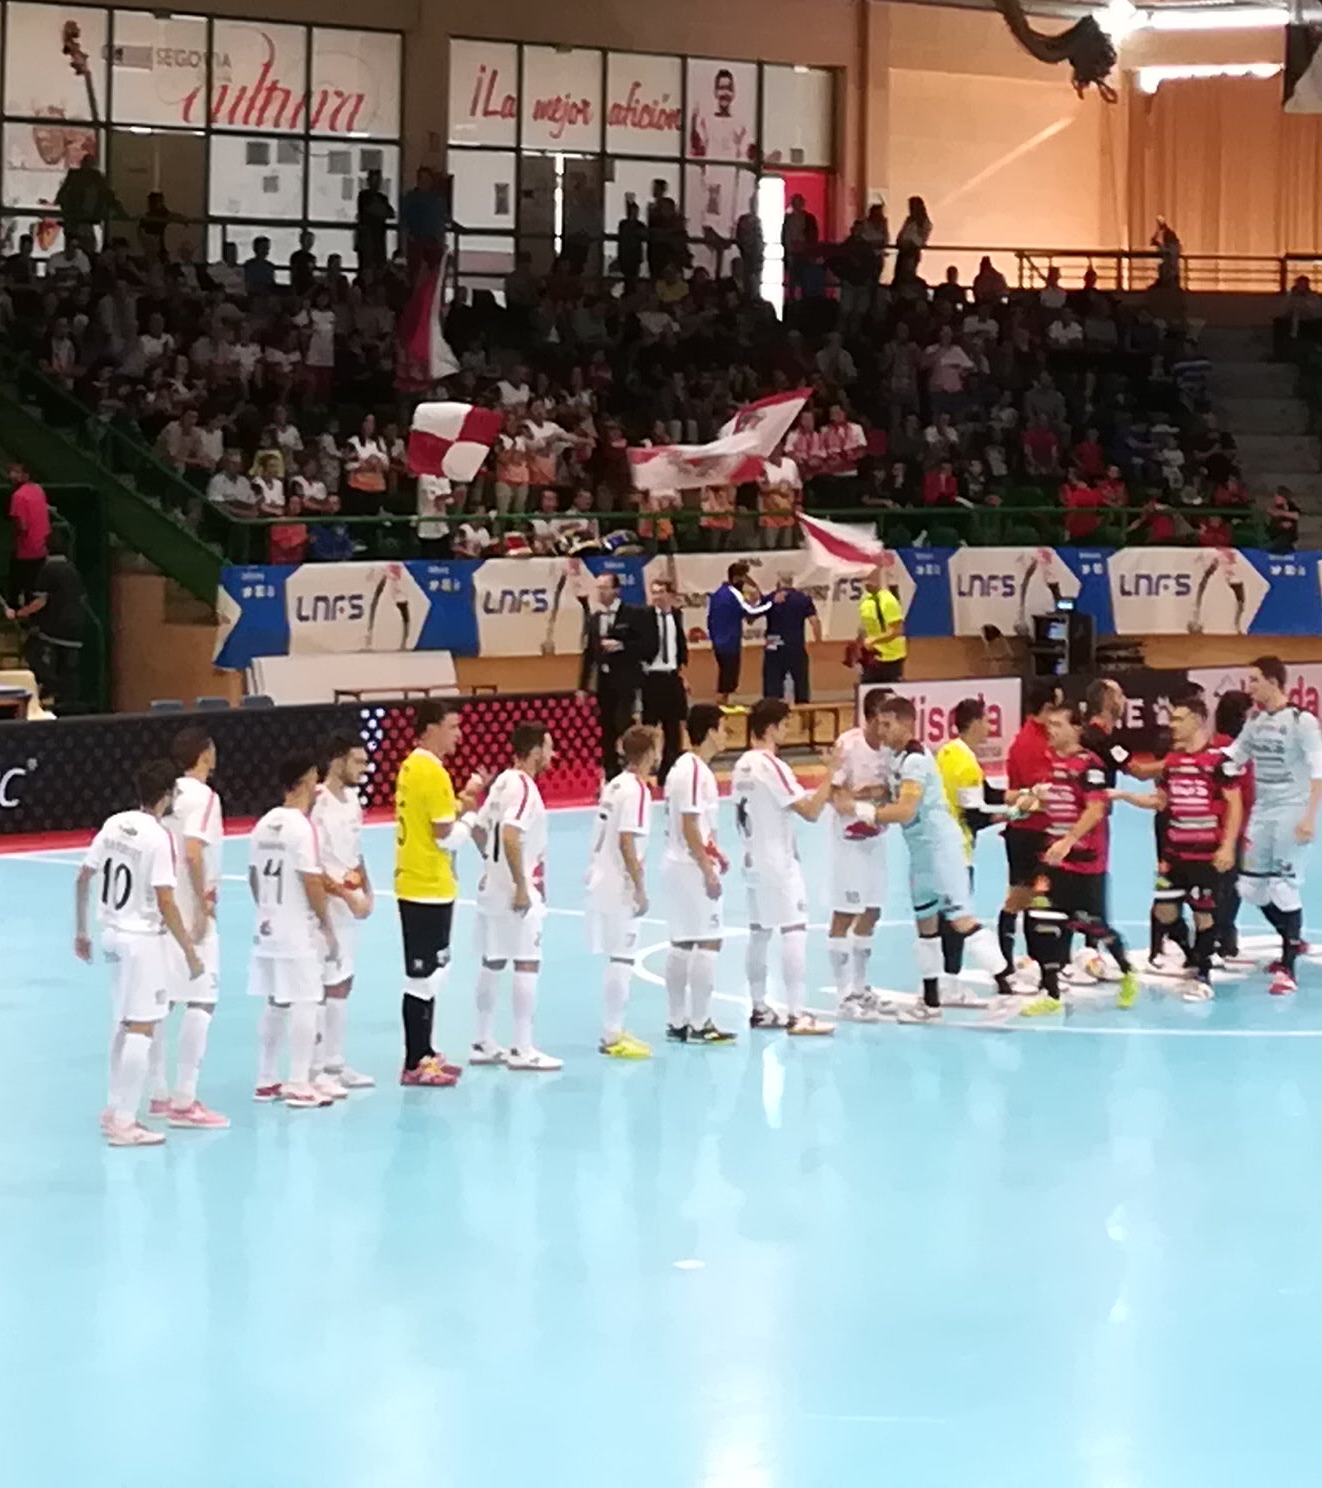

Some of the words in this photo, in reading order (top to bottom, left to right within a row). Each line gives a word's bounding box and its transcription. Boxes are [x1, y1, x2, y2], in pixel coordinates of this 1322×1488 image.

[157, 47, 232, 69] SEGOIA
[532, 92, 591, 139] mejor
[832, 577, 864, 602] FS
[957, 574, 1015, 598] LNFS
[1120, 573, 1191, 598] LNFS
[296, 594, 364, 622] LNFS
[483, 588, 548, 614] LNFS
[101, 858, 132, 910] 10
